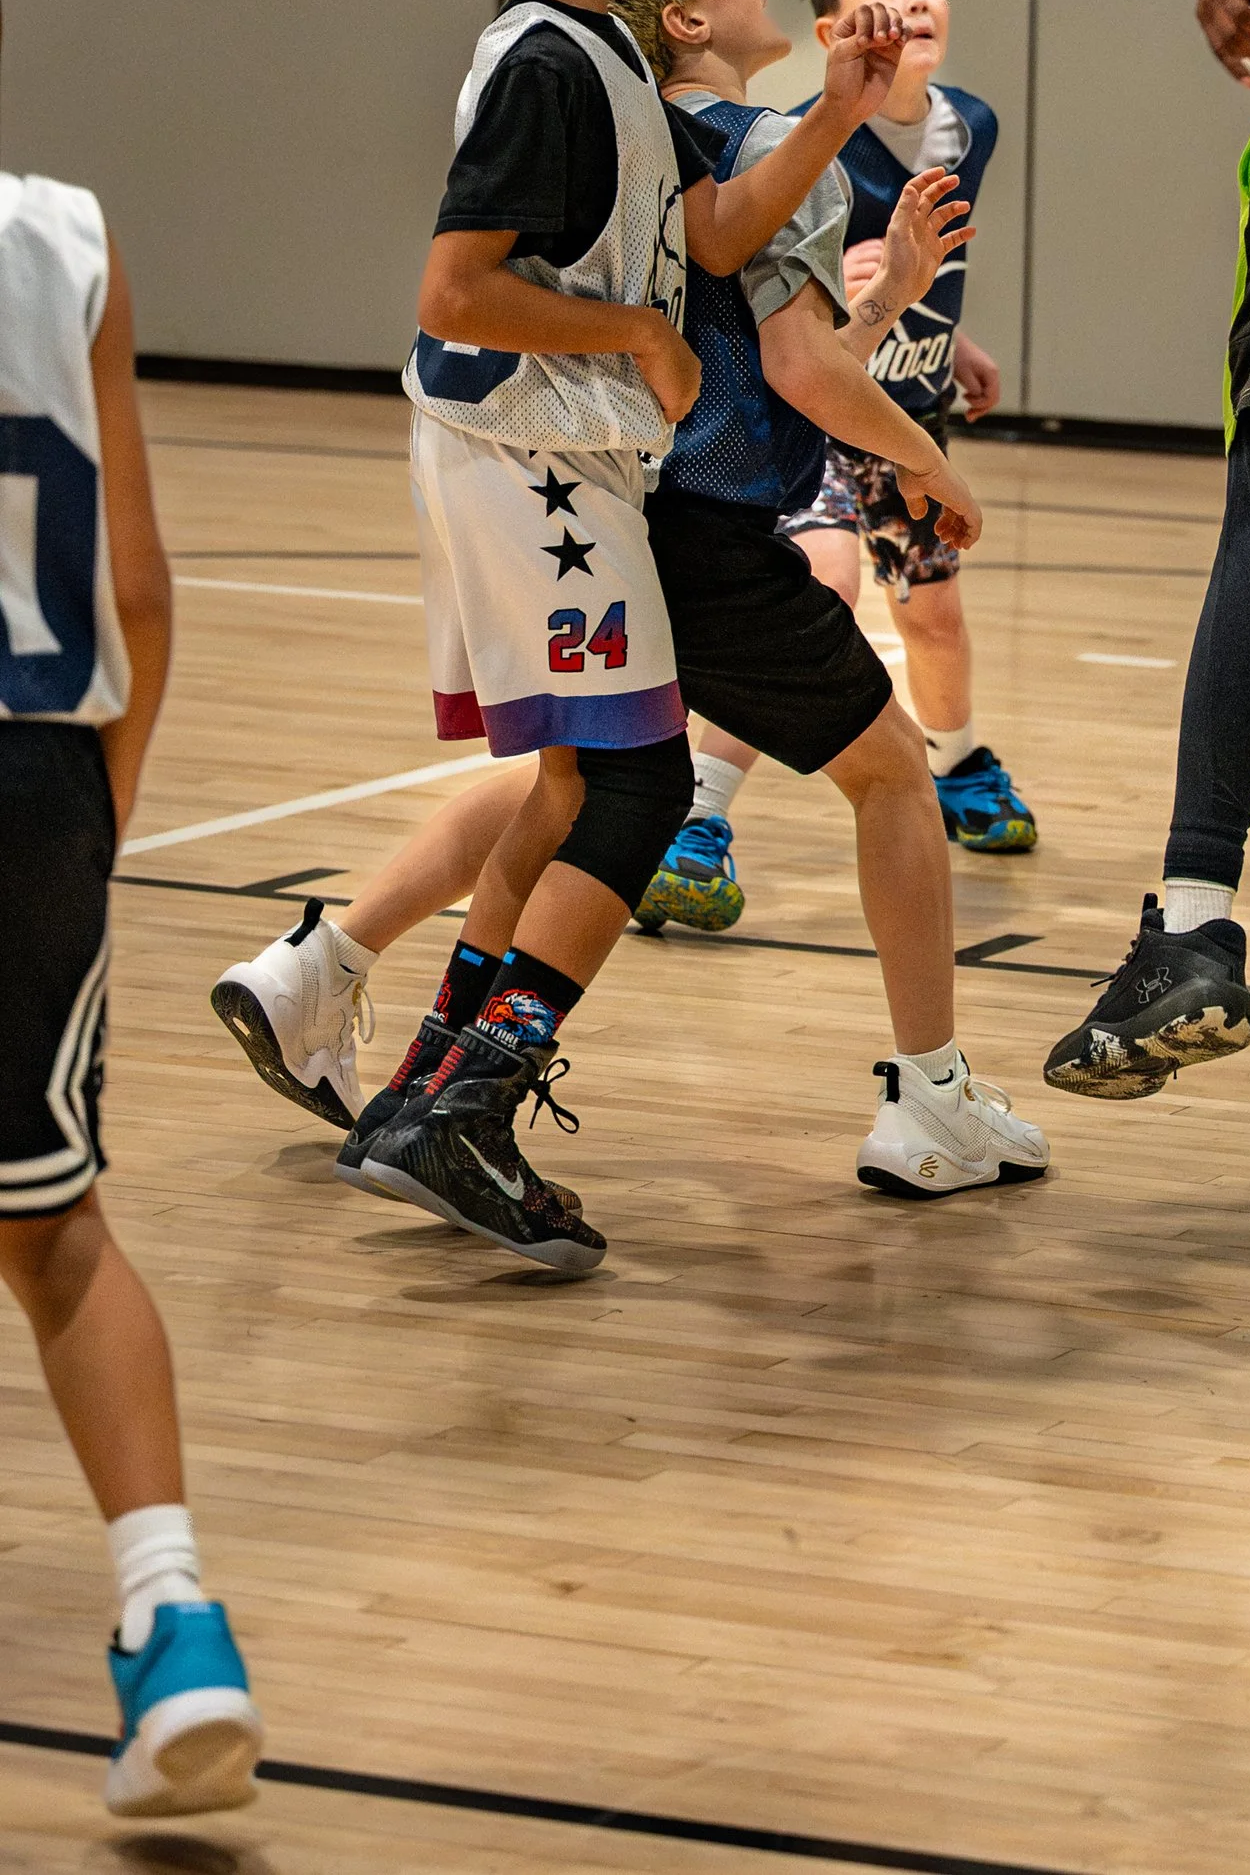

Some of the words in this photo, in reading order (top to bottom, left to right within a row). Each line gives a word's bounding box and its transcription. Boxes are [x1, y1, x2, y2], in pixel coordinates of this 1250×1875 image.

[865, 332, 950, 382] MOCO
[548, 600, 628, 673] 24
[476, 1018, 521, 1045] FUTURE
